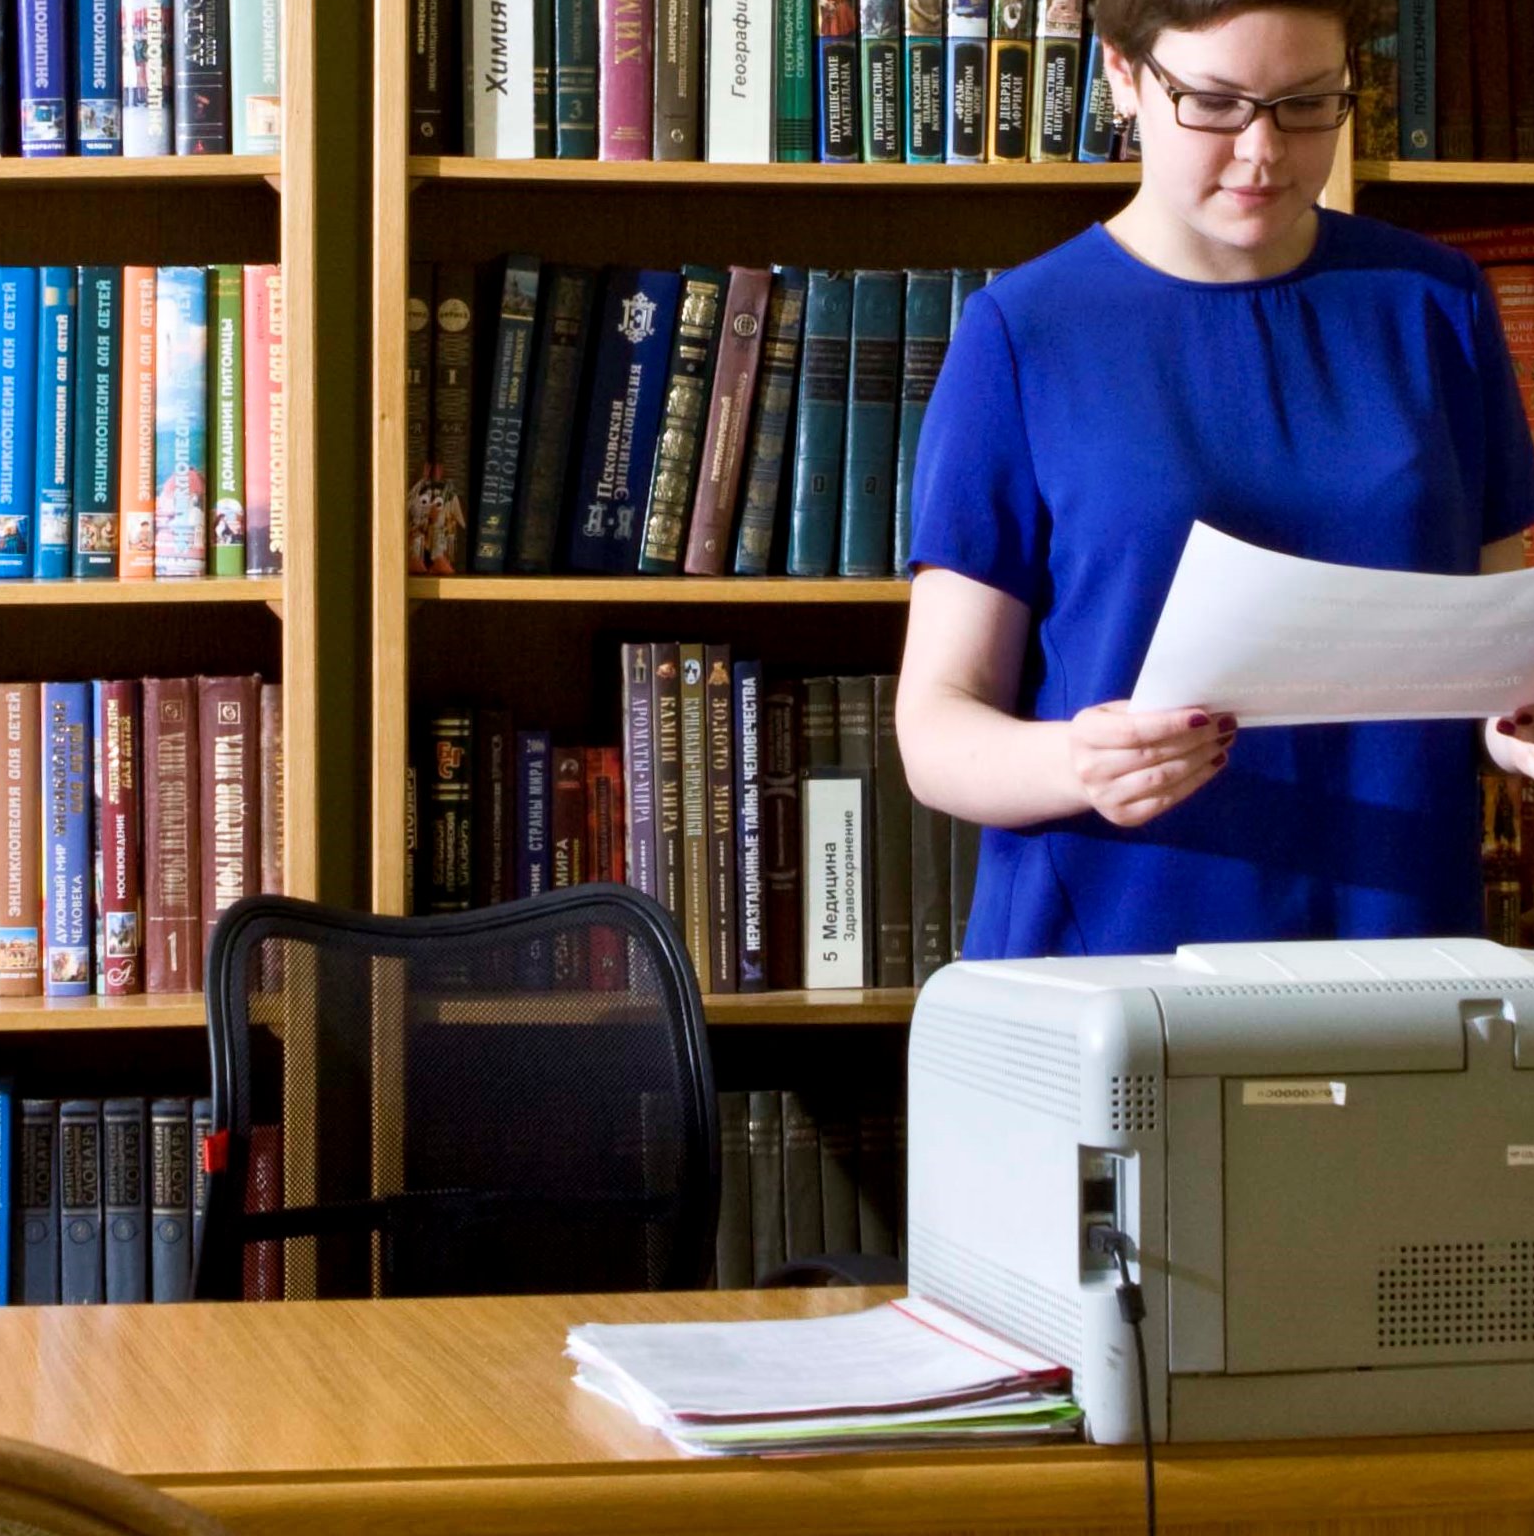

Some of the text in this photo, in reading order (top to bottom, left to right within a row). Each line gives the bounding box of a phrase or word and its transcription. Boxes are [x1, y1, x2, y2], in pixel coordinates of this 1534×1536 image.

[485, 0, 507, 95] Химия
[830, 55, 840, 143] ПУТЕШЕСТВИЕ
[843, 62, 851, 137] МАГЕЛЛАНА
[221, 317, 236, 492] ДОМАШНИЕ ПИТОМЦЫ
[597, 399, 624, 500] Псковская
[614, 364, 642, 501] Энциклопедия
[215, 732, 243, 780] МИРА
[711, 697, 730, 835] ЗОЛОТО МИРА
[214, 782, 244, 857] НАРОДОВ
[529, 759, 543, 852] СТРАНЫ МИРА
[743, 676, 762, 952] НЕРАЗГАДАННЫЕ ТАЙНЫ ЧЕЛОВЕЧЕСТВА
[55, 843, 68, 945] ДУХОВНЫЙ МИР
[116, 814, 126, 900] МОСКВОВЕДЕНИЕ
[821, 841, 838, 962] 5 Медицина
[841, 810, 857, 942] Здравоохранение
[71, 874, 83, 945] ЧЕЛОВЕКА
[167, 932, 178, 972] 1
